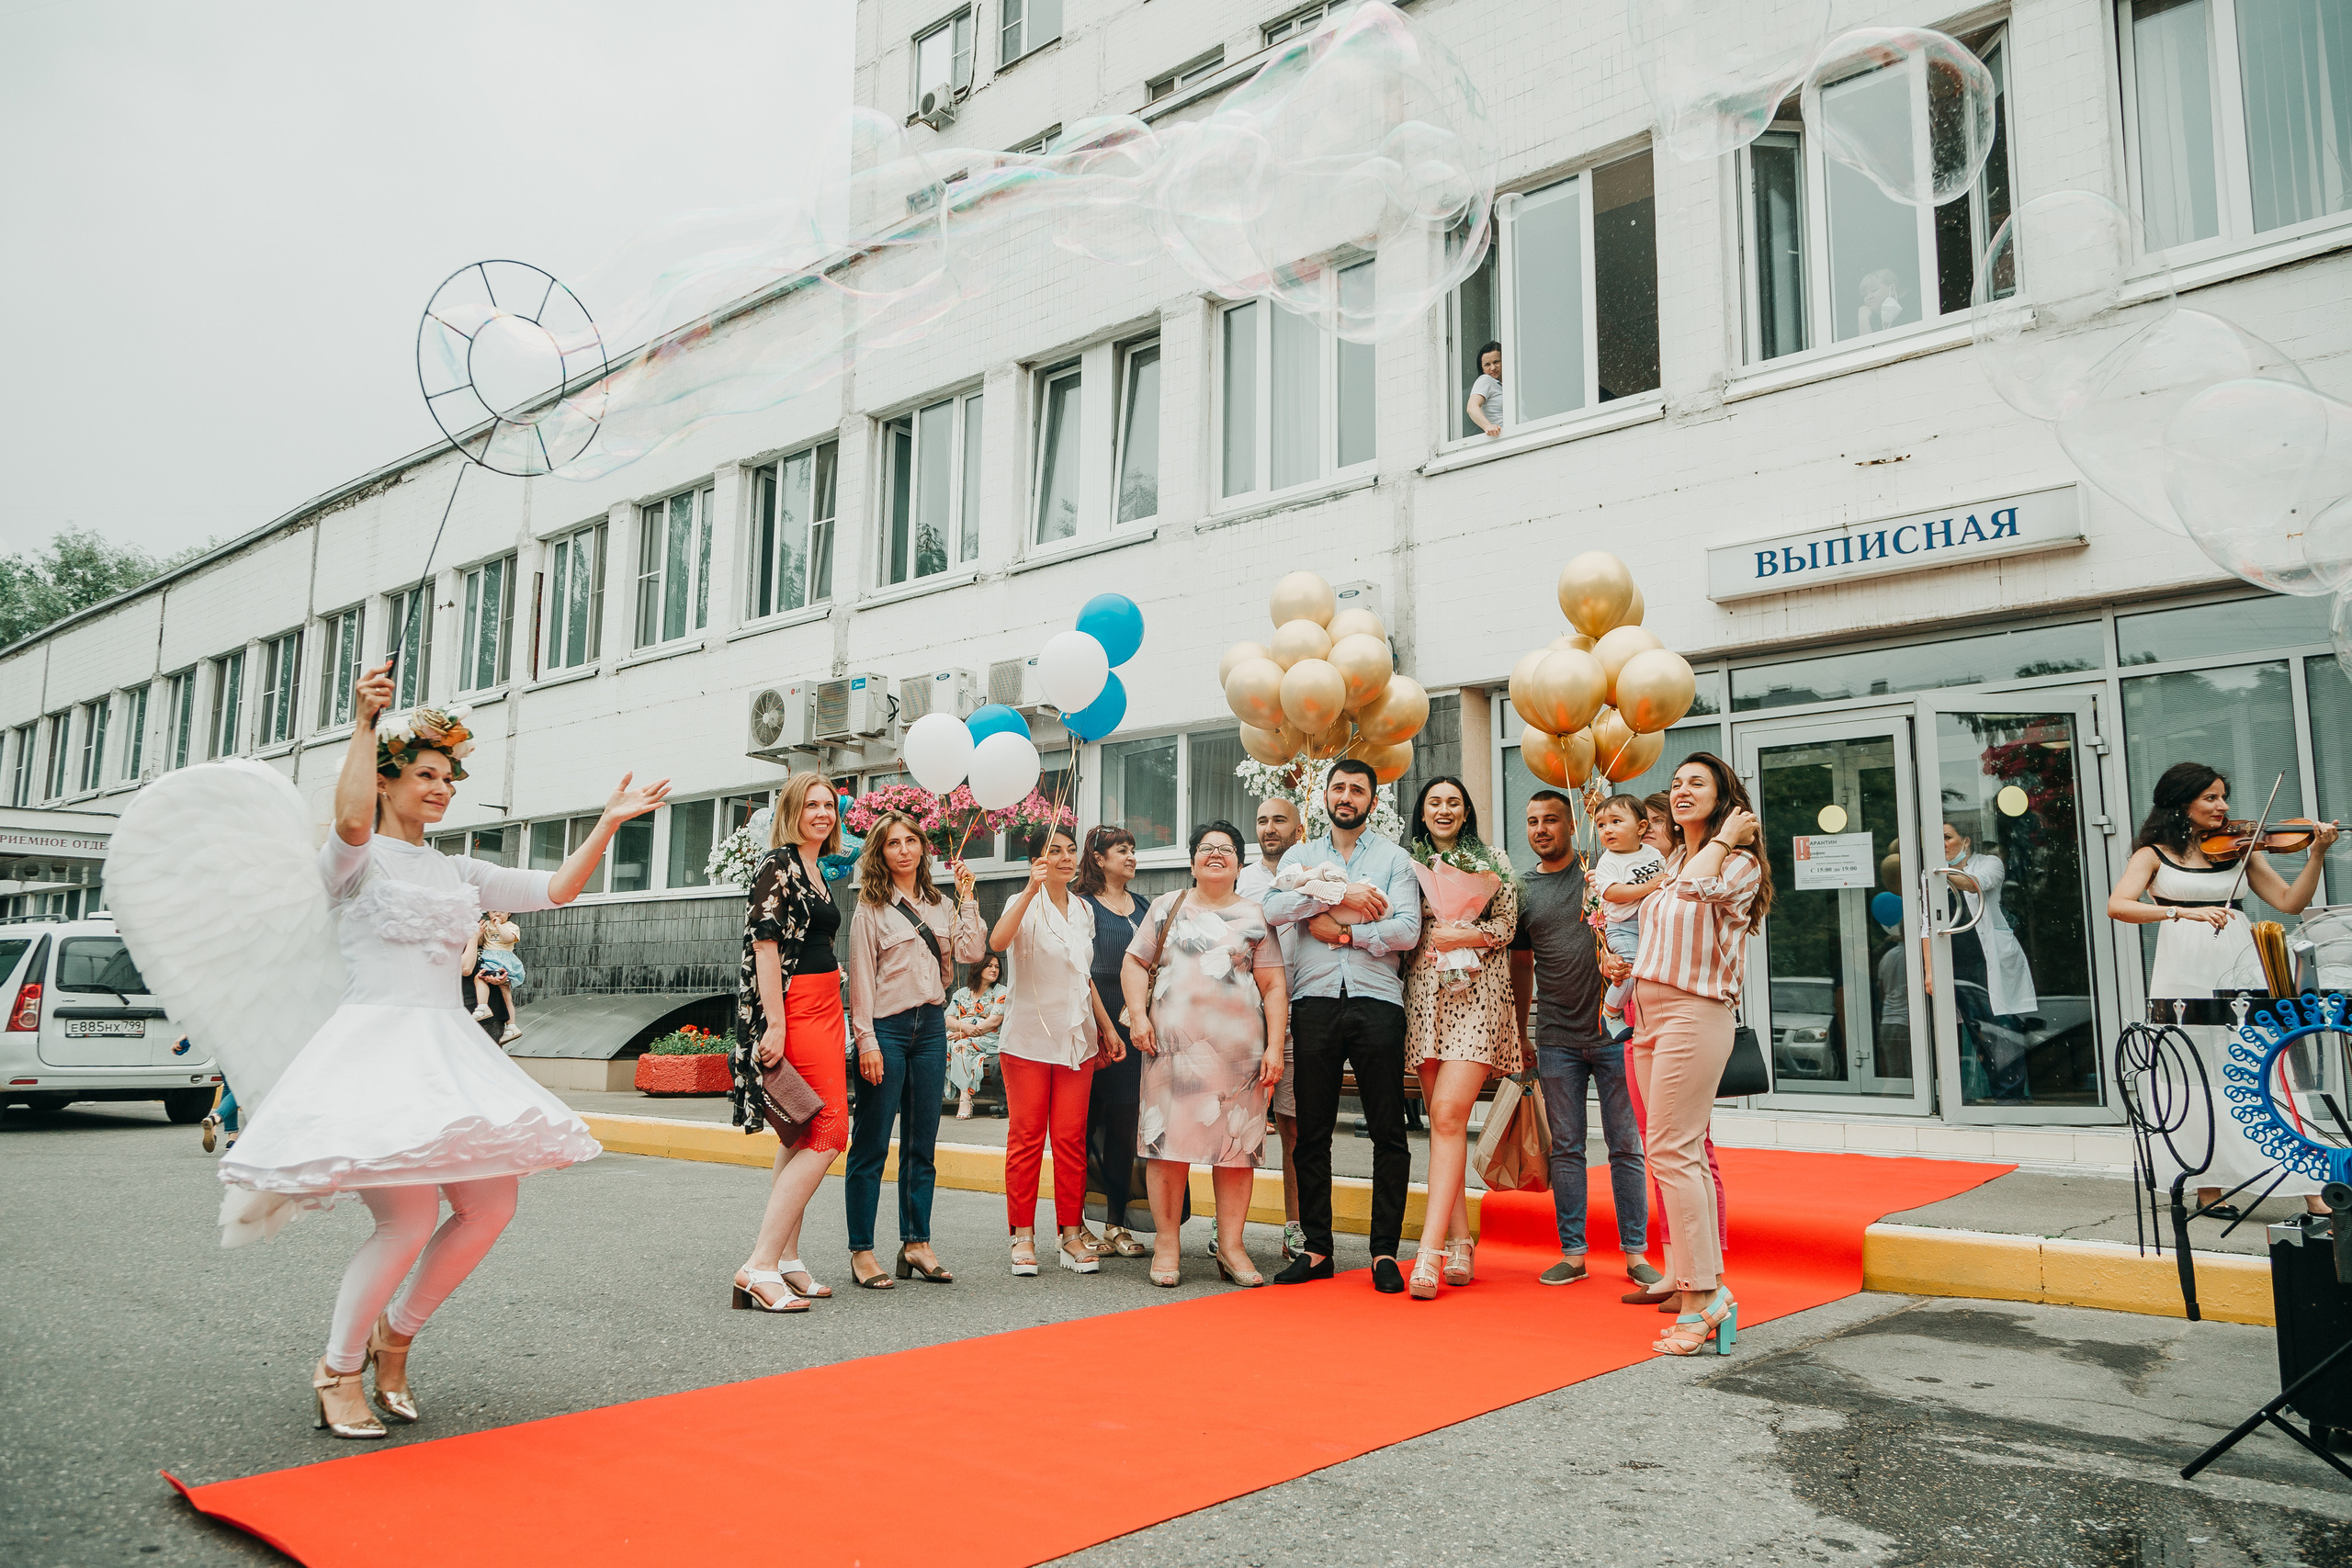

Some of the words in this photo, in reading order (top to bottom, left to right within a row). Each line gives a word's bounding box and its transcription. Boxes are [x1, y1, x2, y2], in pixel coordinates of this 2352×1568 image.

[1754, 506, 2020, 579] ВЫПИСНАЯ
[0, 834, 68, 847] РИЕМНОЕ
[73, 840, 109, 850] ОТДЕ
[1632, 859, 1659, 878] BES
